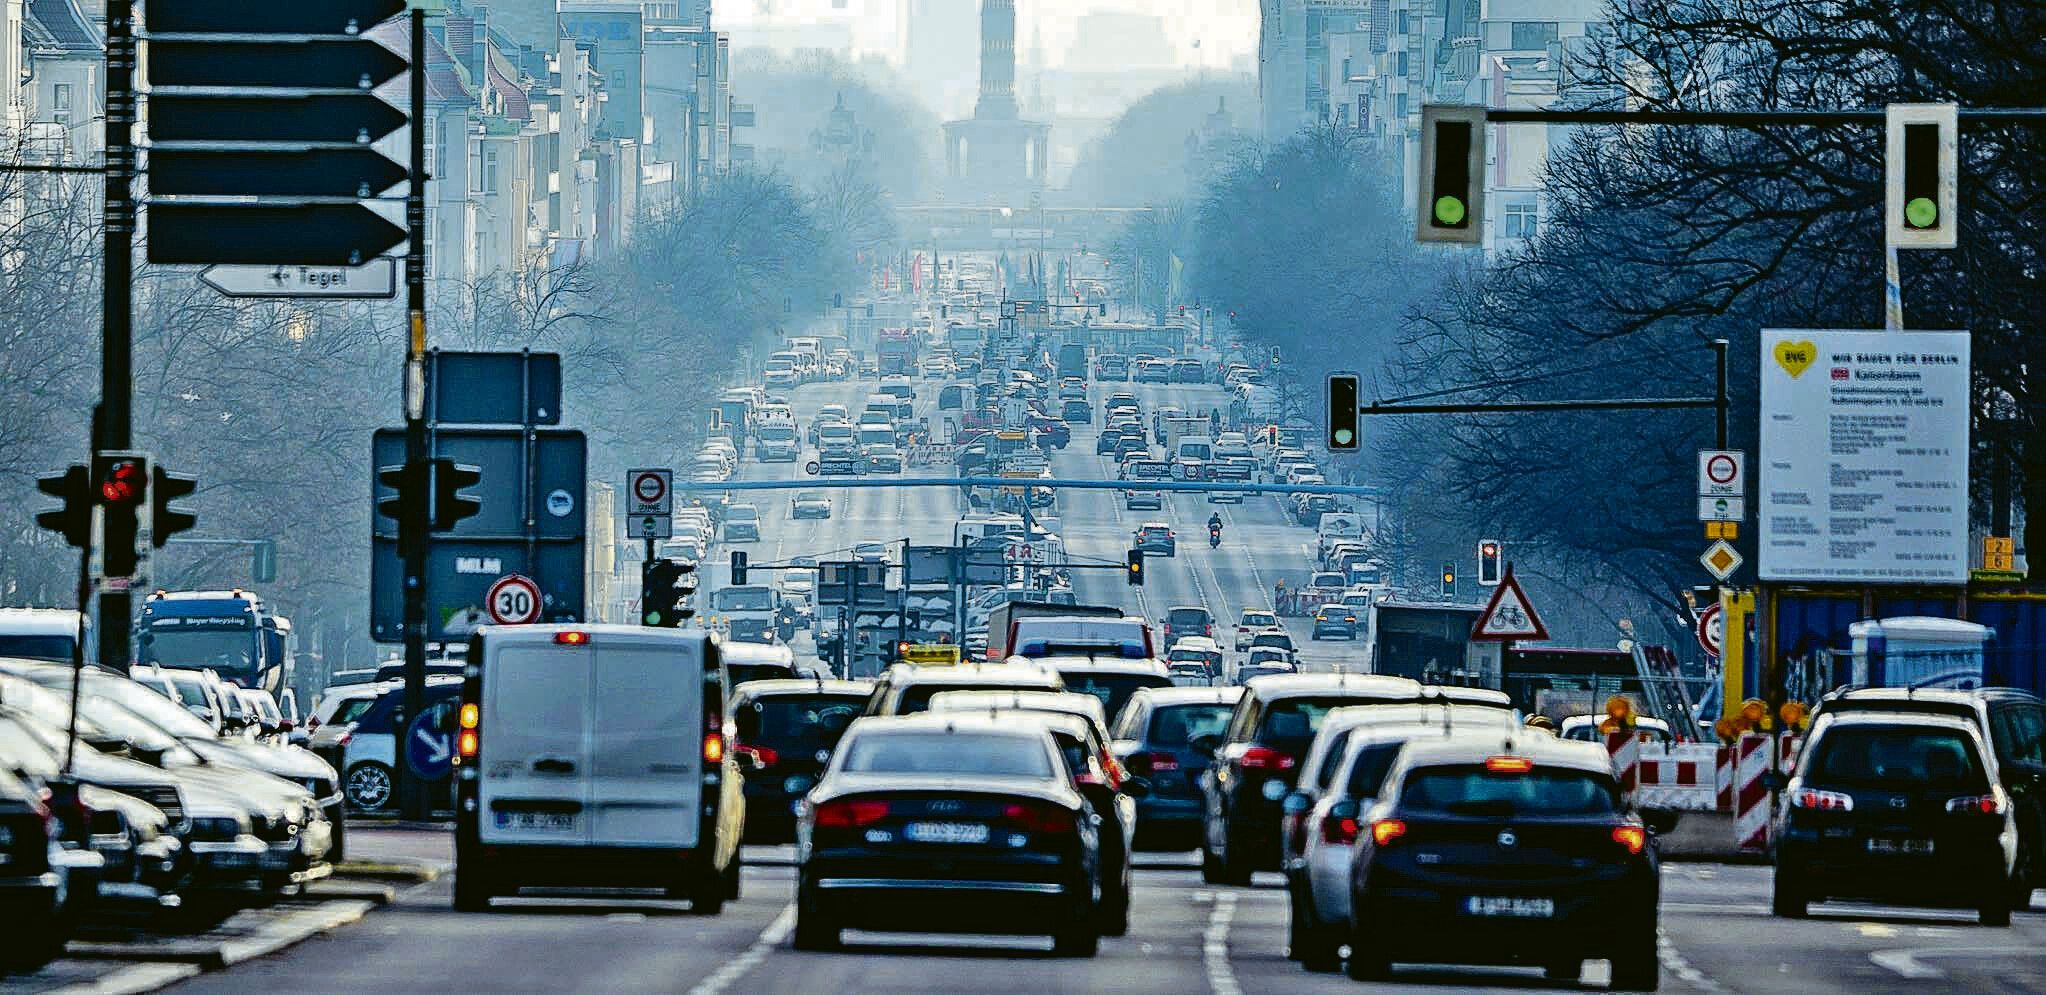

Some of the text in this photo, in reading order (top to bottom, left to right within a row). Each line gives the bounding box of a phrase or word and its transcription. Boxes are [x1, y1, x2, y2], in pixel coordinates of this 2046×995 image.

[299, 266, 347, 288] Tegel
[1785, 351, 1806, 363] BVG
[1832, 351, 1959, 365] WIR BAUEN FÜR BERLIN
[639, 503, 661, 513] ZONE
[500, 591, 529, 617] 30
